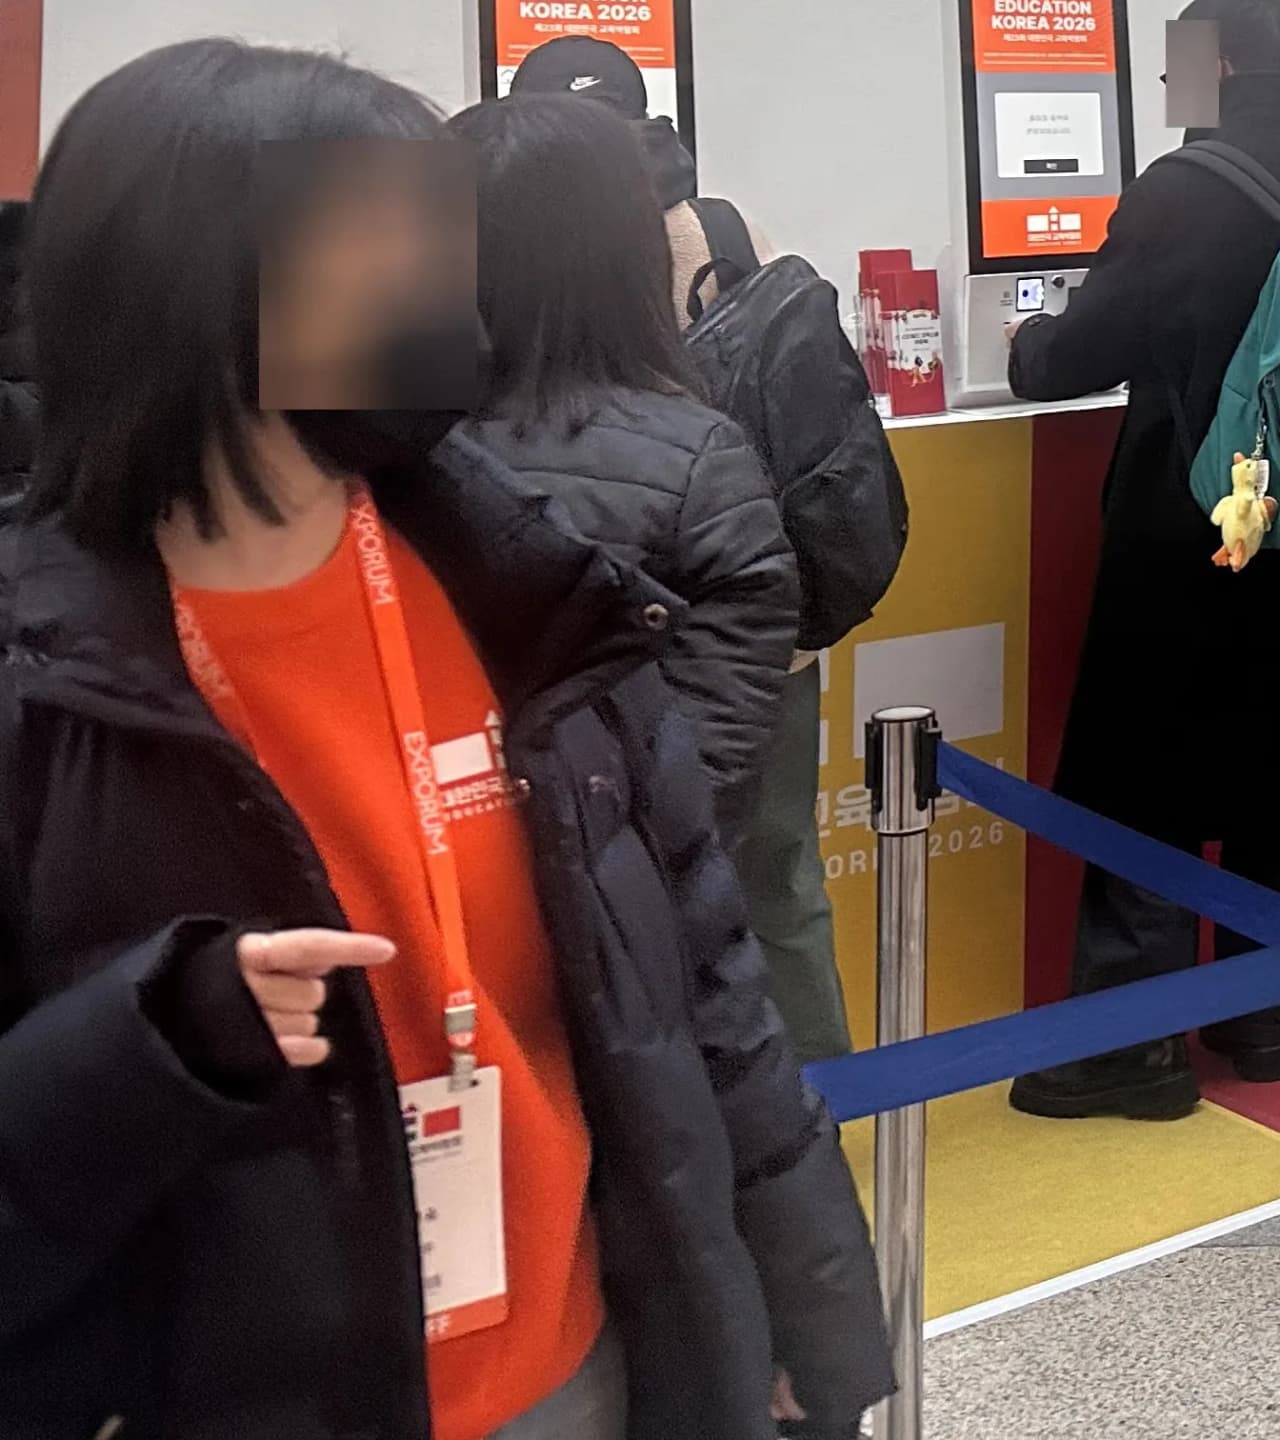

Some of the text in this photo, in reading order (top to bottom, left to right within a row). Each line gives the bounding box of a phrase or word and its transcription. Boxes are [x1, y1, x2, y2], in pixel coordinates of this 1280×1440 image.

[520, 2, 652, 21] KOREA 2026
[991, 15, 1096, 31] KOREA 2026
[403, 731, 449, 855] EXPORUM
[928, 820, 1004, 858] 2026
